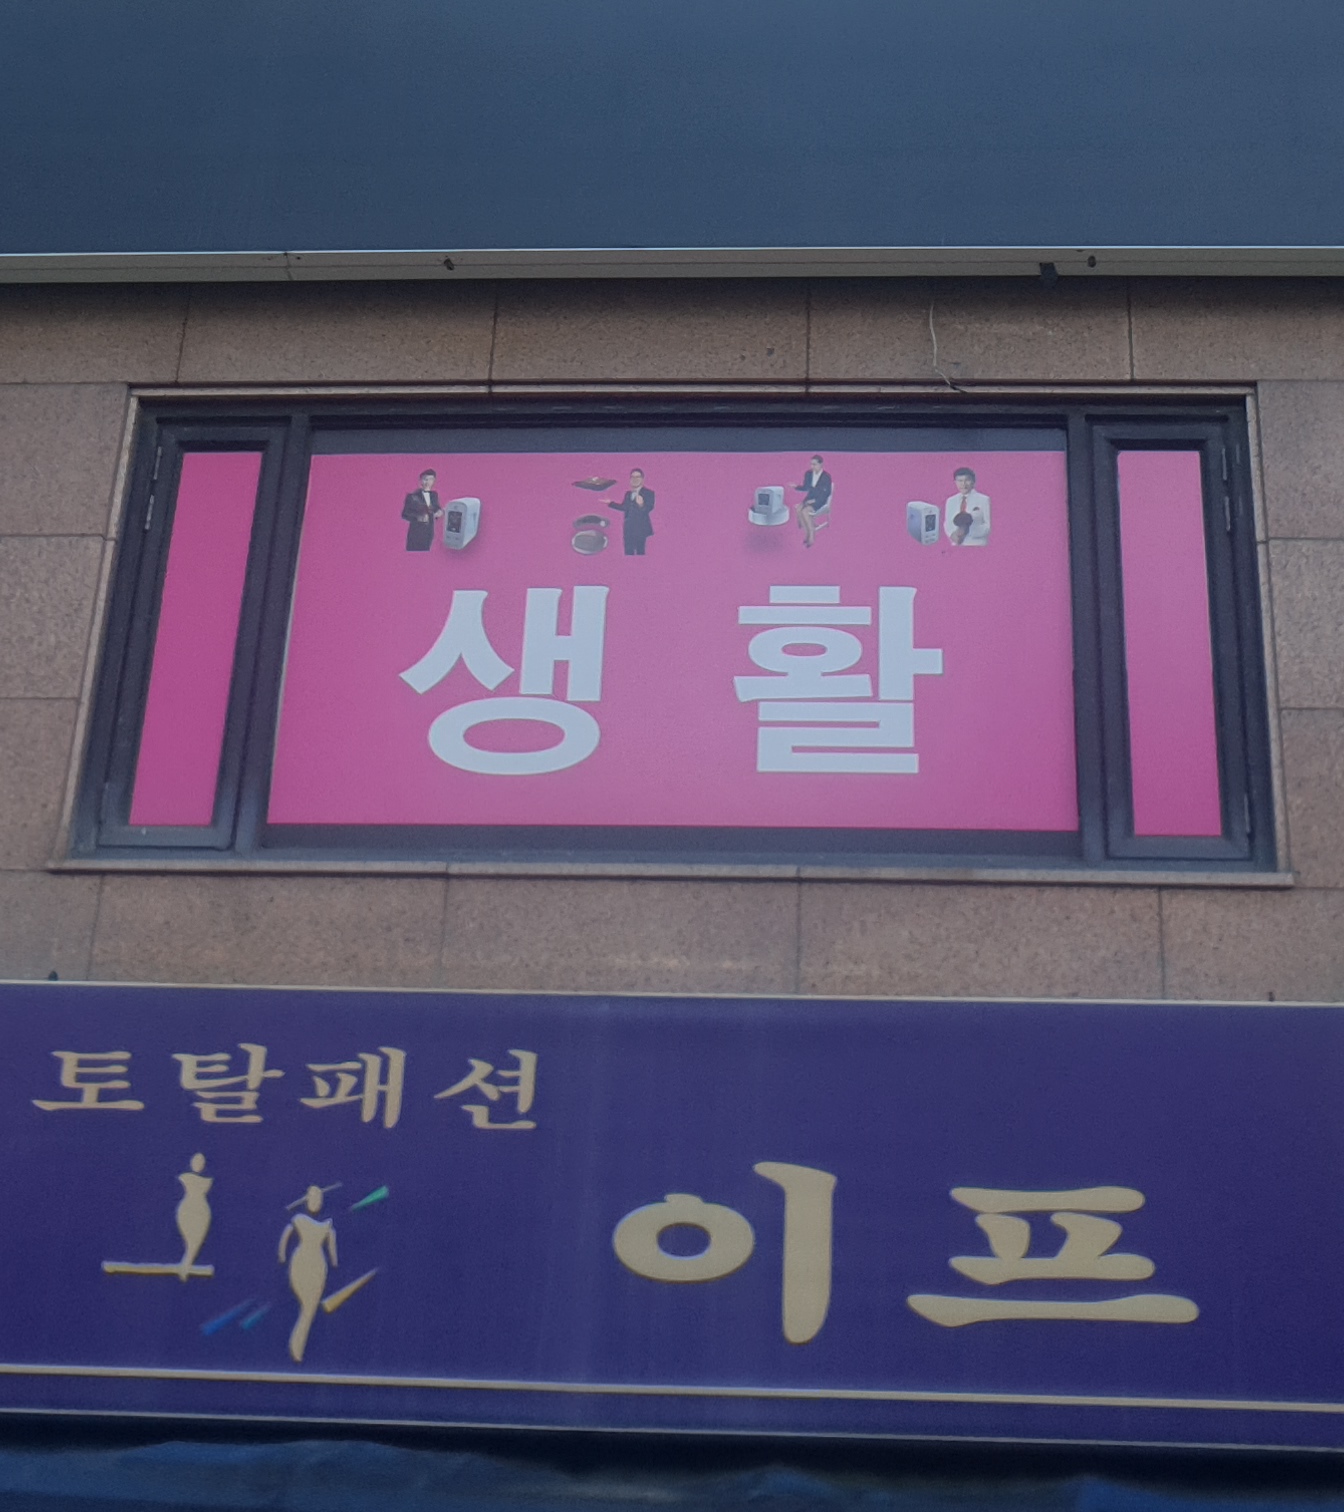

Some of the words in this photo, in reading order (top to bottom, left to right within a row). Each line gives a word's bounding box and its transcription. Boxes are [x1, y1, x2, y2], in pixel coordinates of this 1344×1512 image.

[399, 585, 943, 776] 생활
[32, 1043, 539, 1130] 토탈패션
[613, 1161, 1201, 1344] 이프
